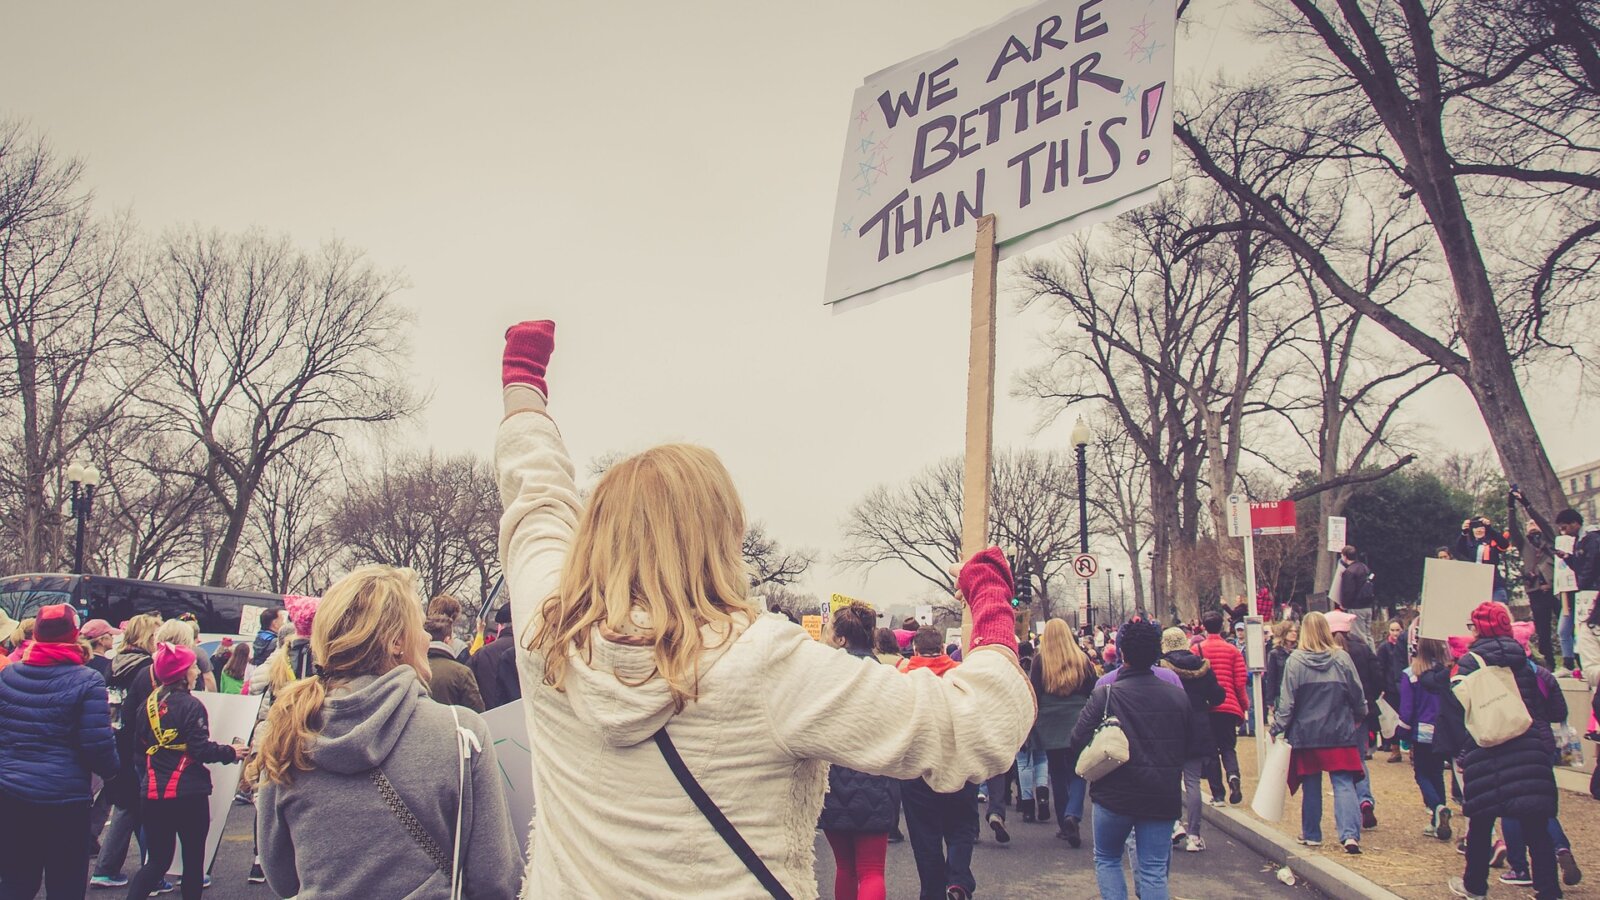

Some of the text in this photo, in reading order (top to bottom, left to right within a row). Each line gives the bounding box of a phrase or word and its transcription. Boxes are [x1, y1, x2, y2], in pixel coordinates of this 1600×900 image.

[877, 0, 1109, 129] WE ARE
[911, 52, 1124, 184] BETTER
[859, 168, 986, 262] THAN
